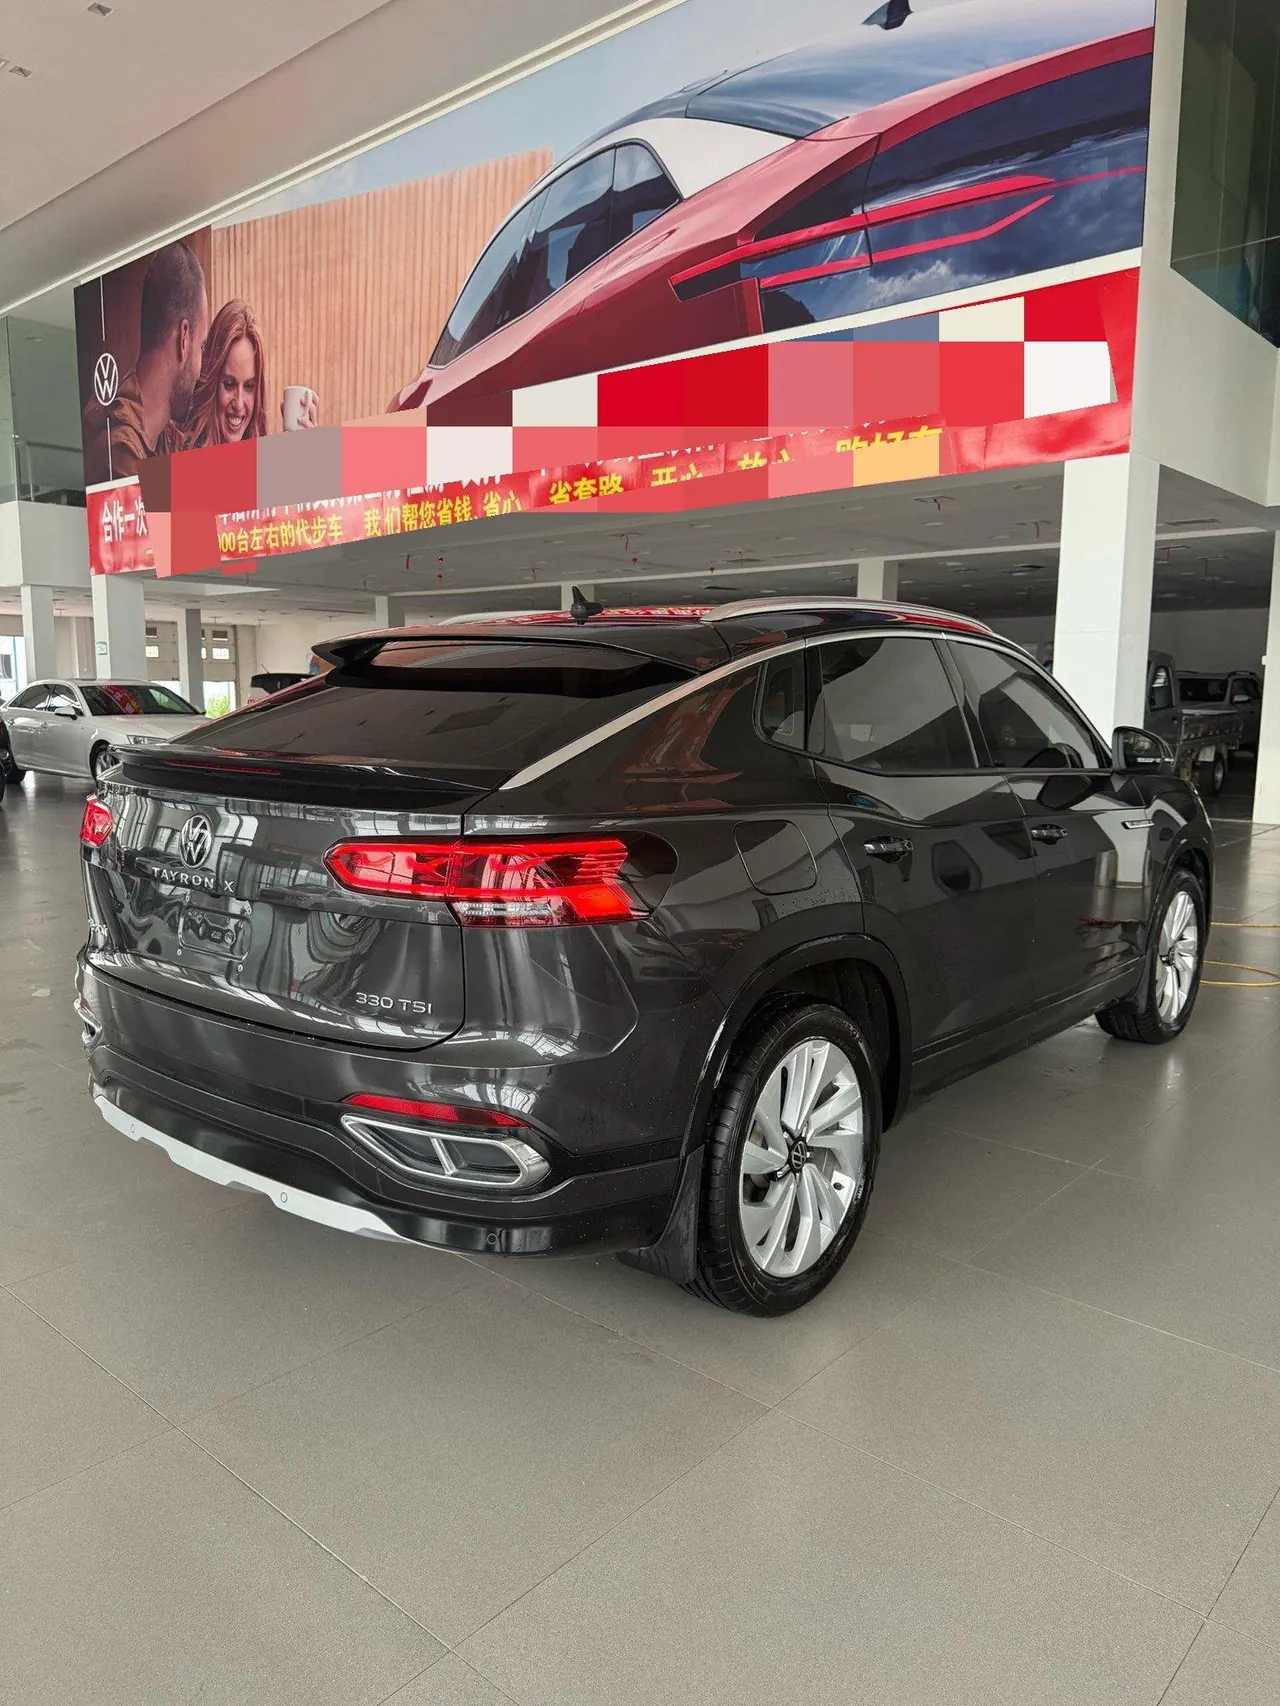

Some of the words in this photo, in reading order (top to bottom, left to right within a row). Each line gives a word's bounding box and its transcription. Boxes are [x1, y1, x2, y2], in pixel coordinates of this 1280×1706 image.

[152, 867, 215, 889] TAYRON
[224, 880, 235, 893] X
[355, 992, 394, 1009] 330
[398, 999, 432, 1014] TSI
